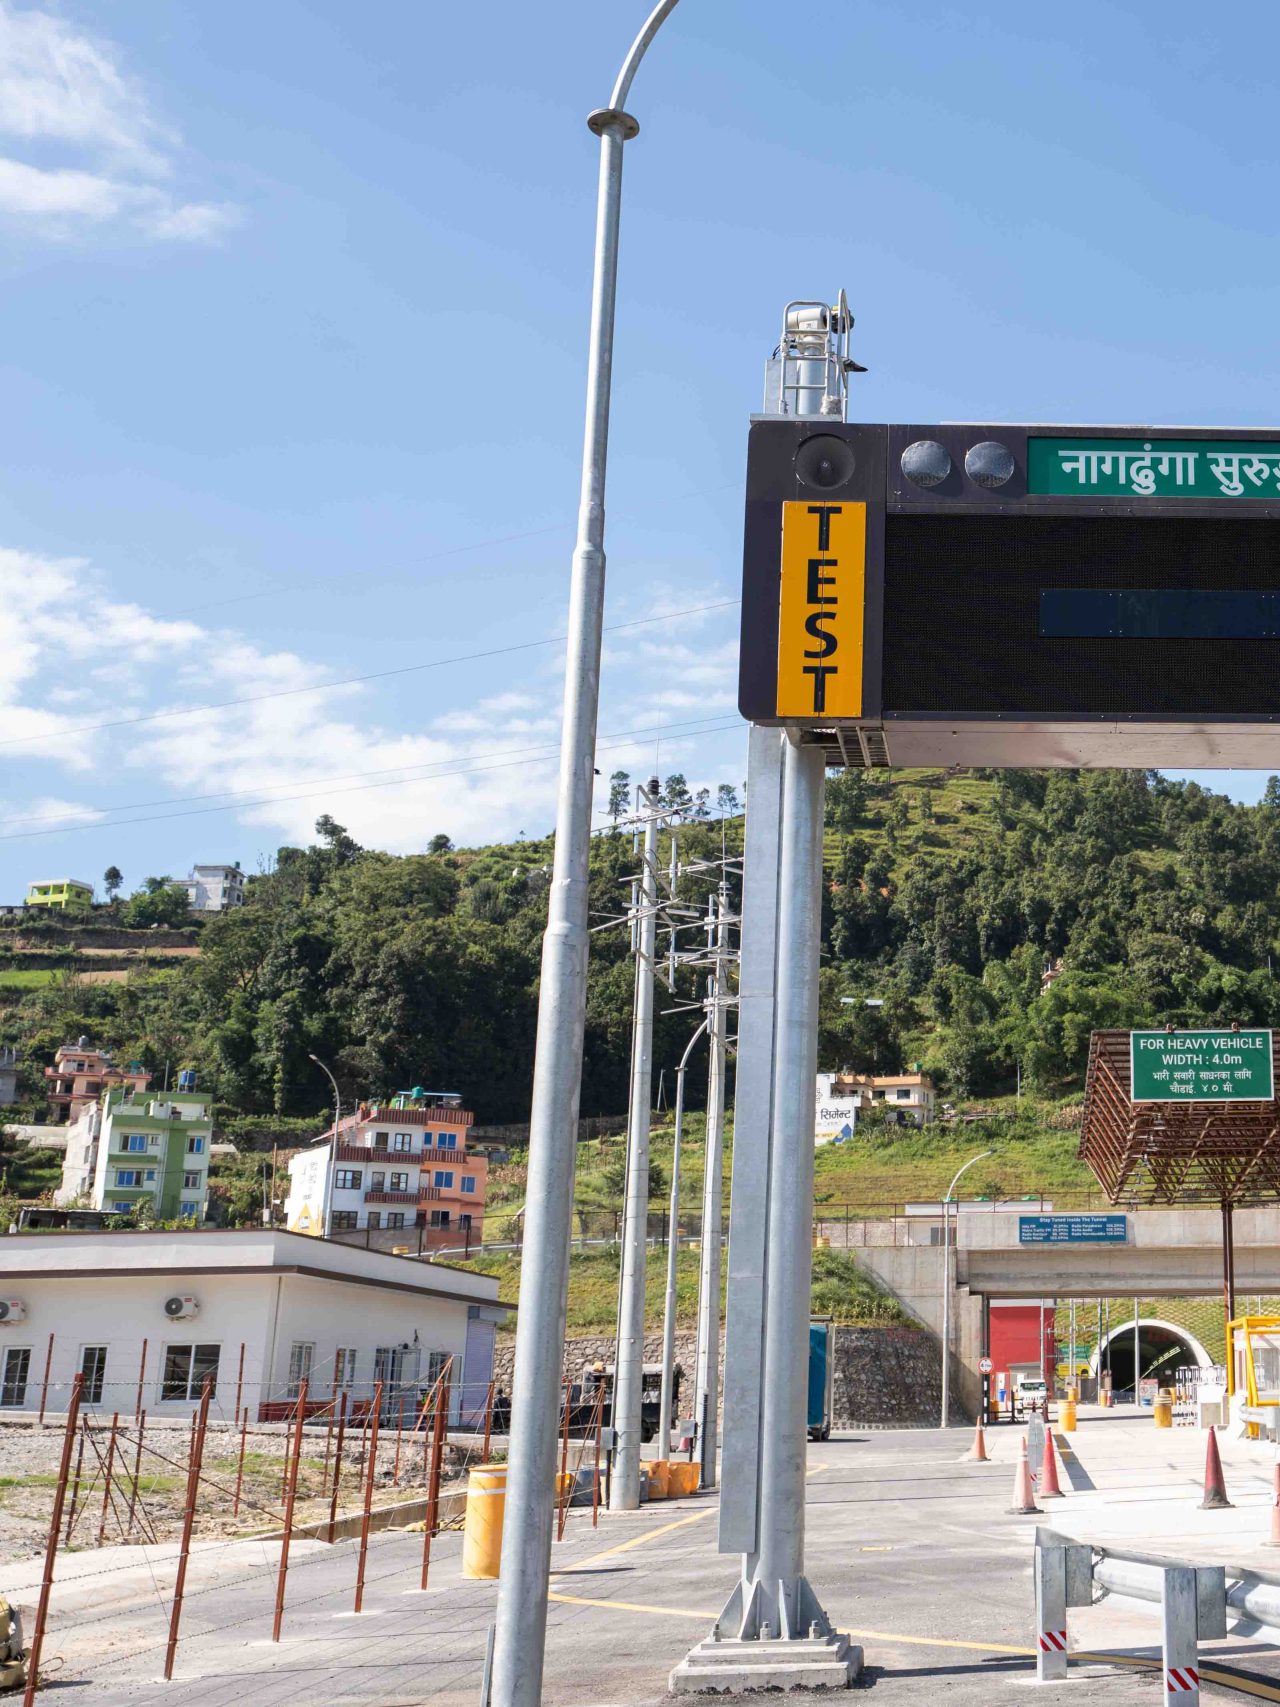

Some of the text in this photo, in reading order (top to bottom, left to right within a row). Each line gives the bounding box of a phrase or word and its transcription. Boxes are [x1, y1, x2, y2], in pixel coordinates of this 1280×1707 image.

[1058, 443, 1199, 495] नागढुंगा
[802, 506, 843, 713] TEST
[1140, 1038, 1263, 1050] FOR HEAVY VEHICLE
[1162, 1054, 1201, 1065] WIDTH
[1212, 1054, 1242, 1065] 4.0m
[1153, 1069, 1170, 1080] भारी
[1200, 1070, 1230, 1080] साधनका
[1234, 1068, 1252, 1079] लागि
